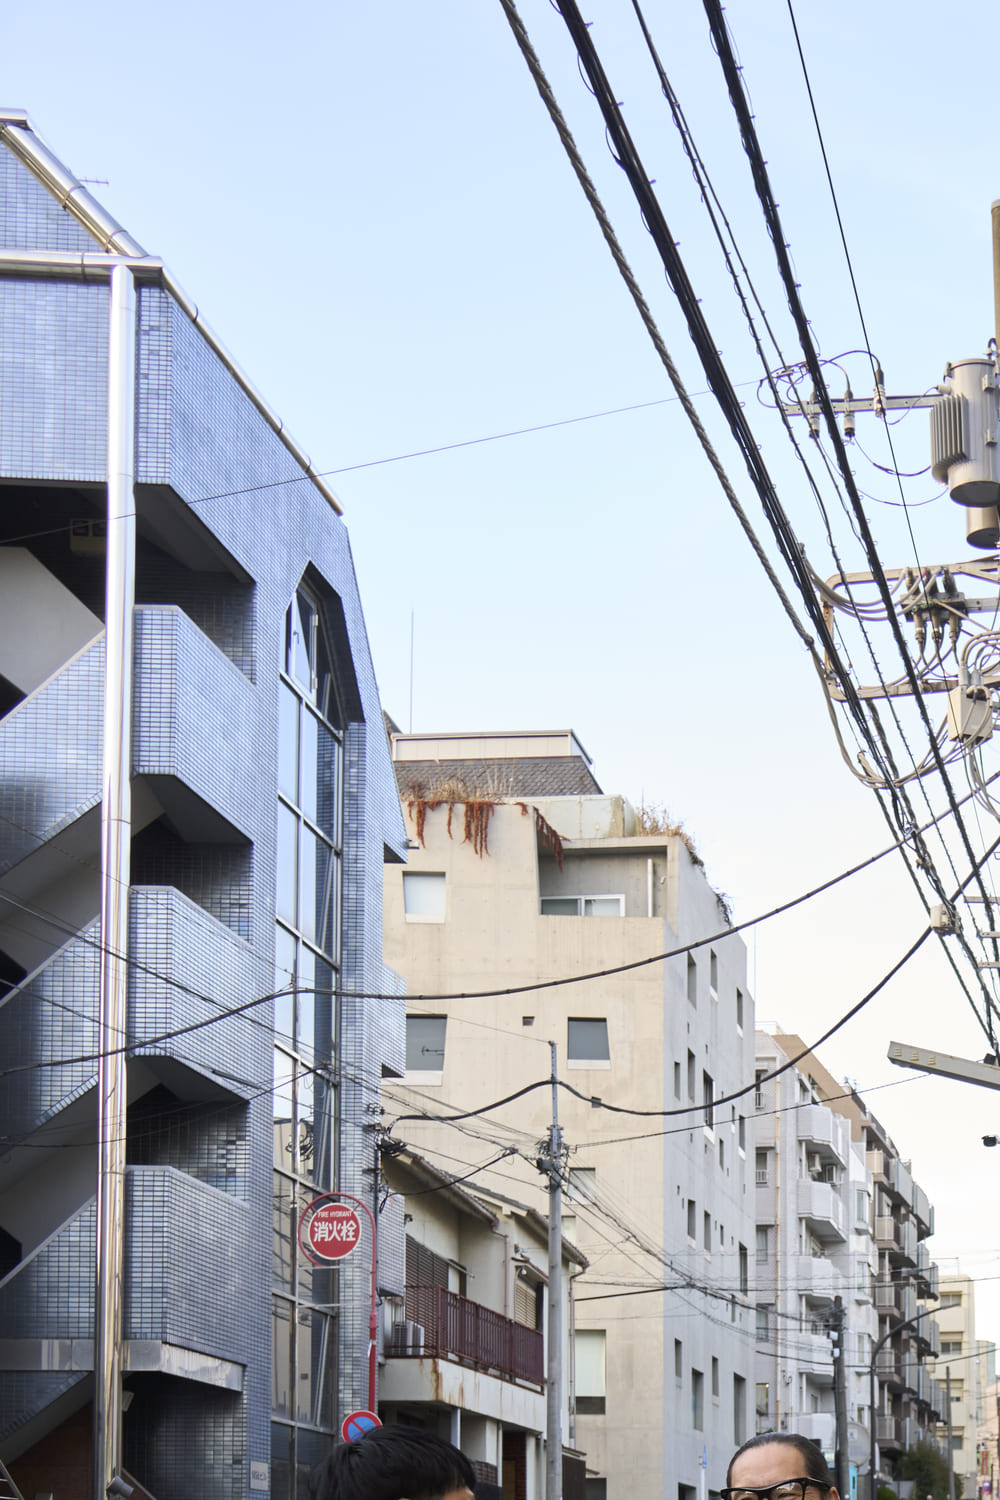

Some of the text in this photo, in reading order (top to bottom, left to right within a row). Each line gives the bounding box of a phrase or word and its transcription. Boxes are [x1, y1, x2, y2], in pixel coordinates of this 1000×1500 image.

[330, 1210, 352, 1218] HYDRANT
[313, 1220, 357, 1242] 消火栓
